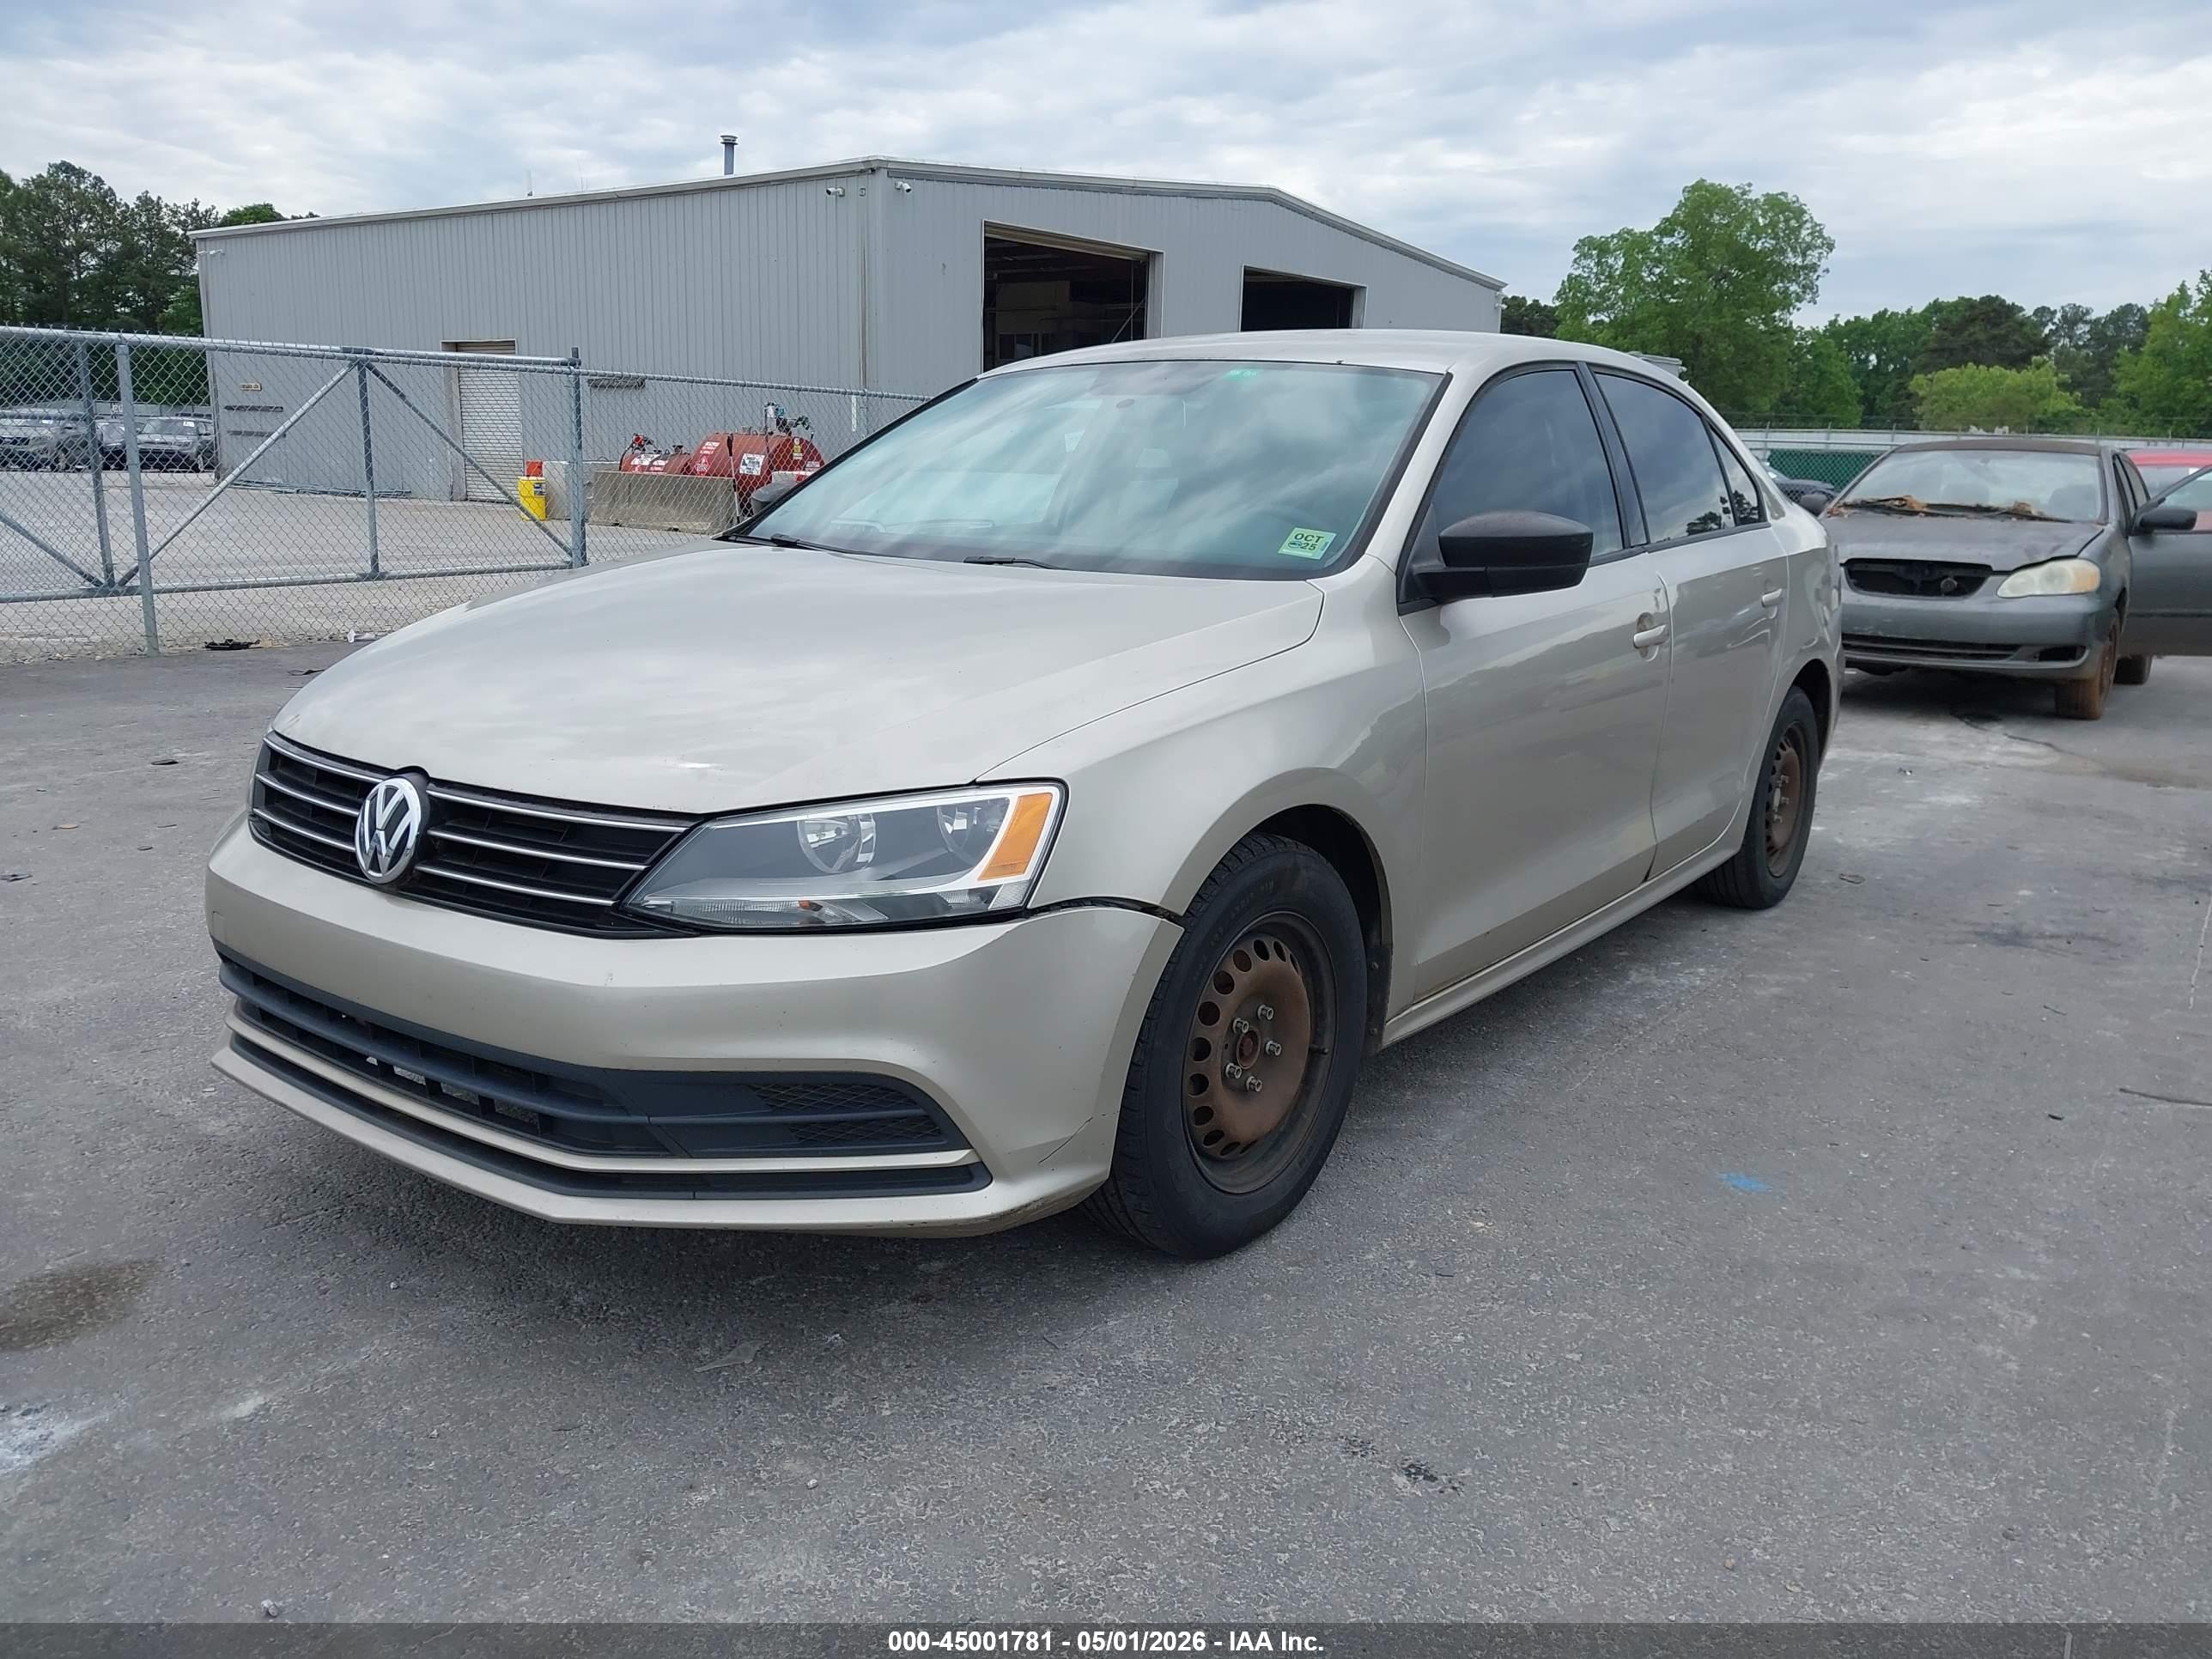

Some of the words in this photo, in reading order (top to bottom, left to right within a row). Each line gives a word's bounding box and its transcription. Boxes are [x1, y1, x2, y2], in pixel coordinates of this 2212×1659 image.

[1294, 533, 1324, 543] OCT
[1300, 542, 1318, 550] 25
[358, 779, 417, 880] VW
